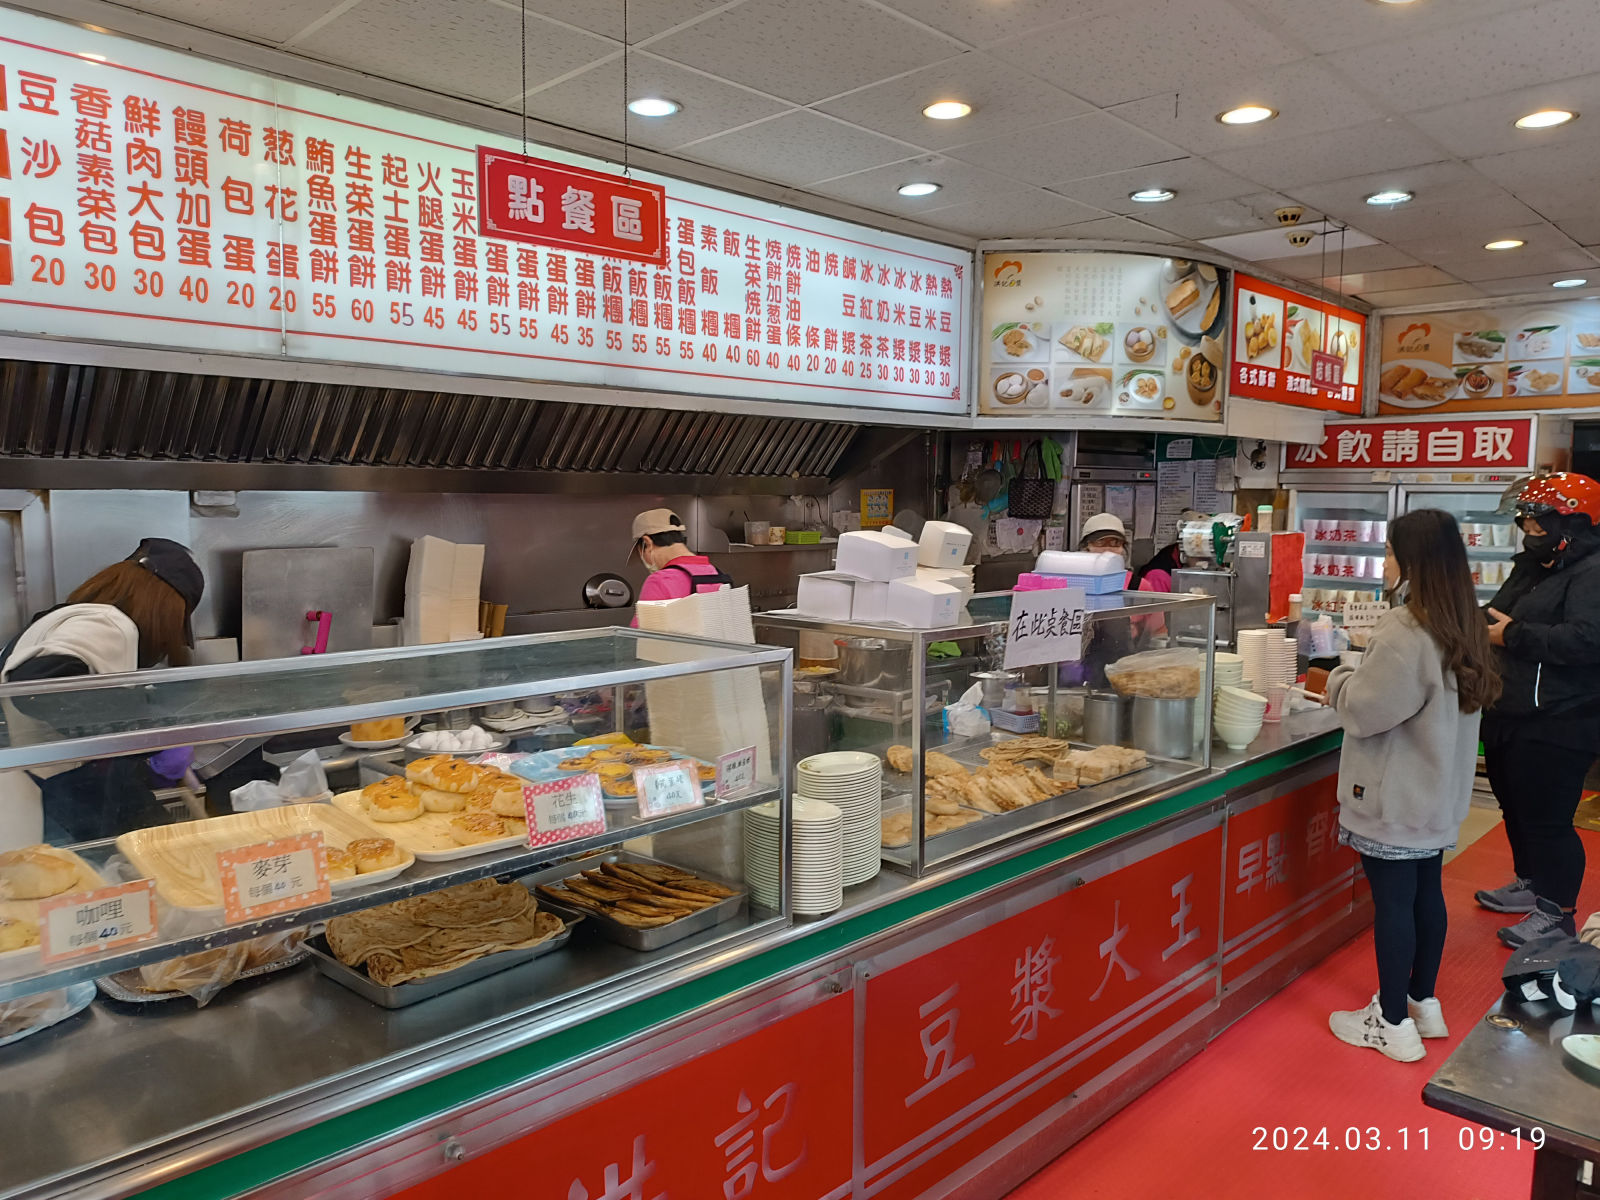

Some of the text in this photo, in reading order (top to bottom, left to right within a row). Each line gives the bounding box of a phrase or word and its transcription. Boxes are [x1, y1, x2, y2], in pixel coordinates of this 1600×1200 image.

[18, 70, 65, 286] 豆沙包 20
[70, 83, 118, 292] 香菇素菜包 30
[123, 95, 166, 298] 鮮肉大包 30
[172, 106, 212, 304] 饅頭加蛋 40
[218, 117, 256, 309] 荷包蛋 20
[507, 174, 644, 242] 點餐區
[305, 136, 339, 319] 鮪魚蛋餅 55
[345, 145, 376, 323] 生菜蛋餅 60
[381, 153, 414, 326] 起士蛋餅 55
[417, 161, 446, 330] 火腿蛋餅 45
[451, 167, 479, 331] 玉米蛋餅 45
[268, 286, 297, 313] 20
[490, 312, 511, 335] 55
[516, 243, 540, 339] 蛋餅 55
[546, 247, 569, 345] 蛋餅 45
[574, 253, 596, 347] 蛋餅 35
[601, 257, 624, 350] 飯糰 55
[628, 260, 649, 353] 飯糰 55
[806, 247, 820, 372] 油條 20
[860, 259, 874, 379] 冰紅茶 25
[877, 263, 891, 381] 冰奶茶 30
[655, 337, 671, 356] 55
[680, 340, 694, 360] 55
[702, 343, 717, 363] 40
[726, 345, 741, 363] 40
[747, 349, 760, 367] 60
[766, 352, 780, 369] 40
[787, 355, 801, 371] 40
[824, 357, 837, 375] 20
[842, 360, 854, 377] 40
[893, 366, 904, 382] 30
[909, 368, 920, 384] 30
[925, 370, 936, 386] 30
[939, 371, 950, 387] 30
[1313, 564, 1354, 577] 冰奶茶
[76, 899, 124, 926] 咖哩
